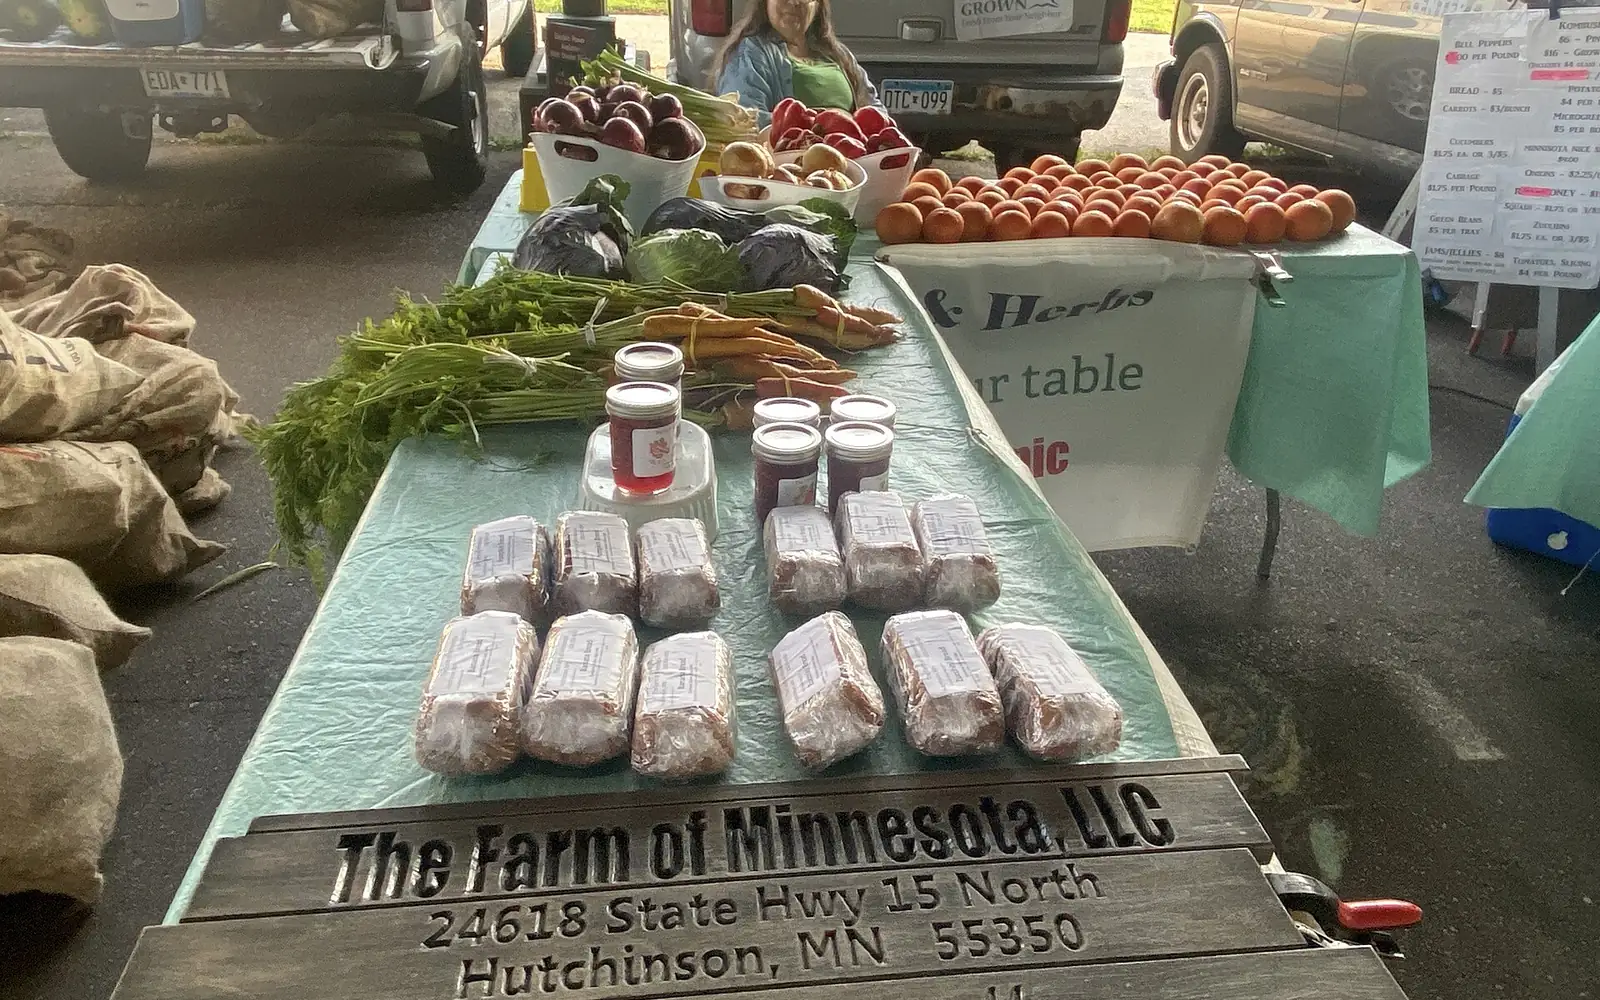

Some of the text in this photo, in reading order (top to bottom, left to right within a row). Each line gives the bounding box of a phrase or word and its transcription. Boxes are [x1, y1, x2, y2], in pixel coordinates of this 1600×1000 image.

[961, 0, 1027, 16] GROWN
[921, 91, 948, 109] 099
[1449, 86, 1480, 95] BREAD
[1492, 87, 1503, 96] $5
[1469, 185, 1497, 193] POUND
[980, 287, 1154, 332] Herbs
[1021, 352, 1144, 400] table
[330, 781, 1177, 904] The Farm of Minnesota, LLC
[420, 863, 1105, 950] 24618 State Hwy 15 North
[455, 912, 1086, 999] Hutchinson, MN 55350
